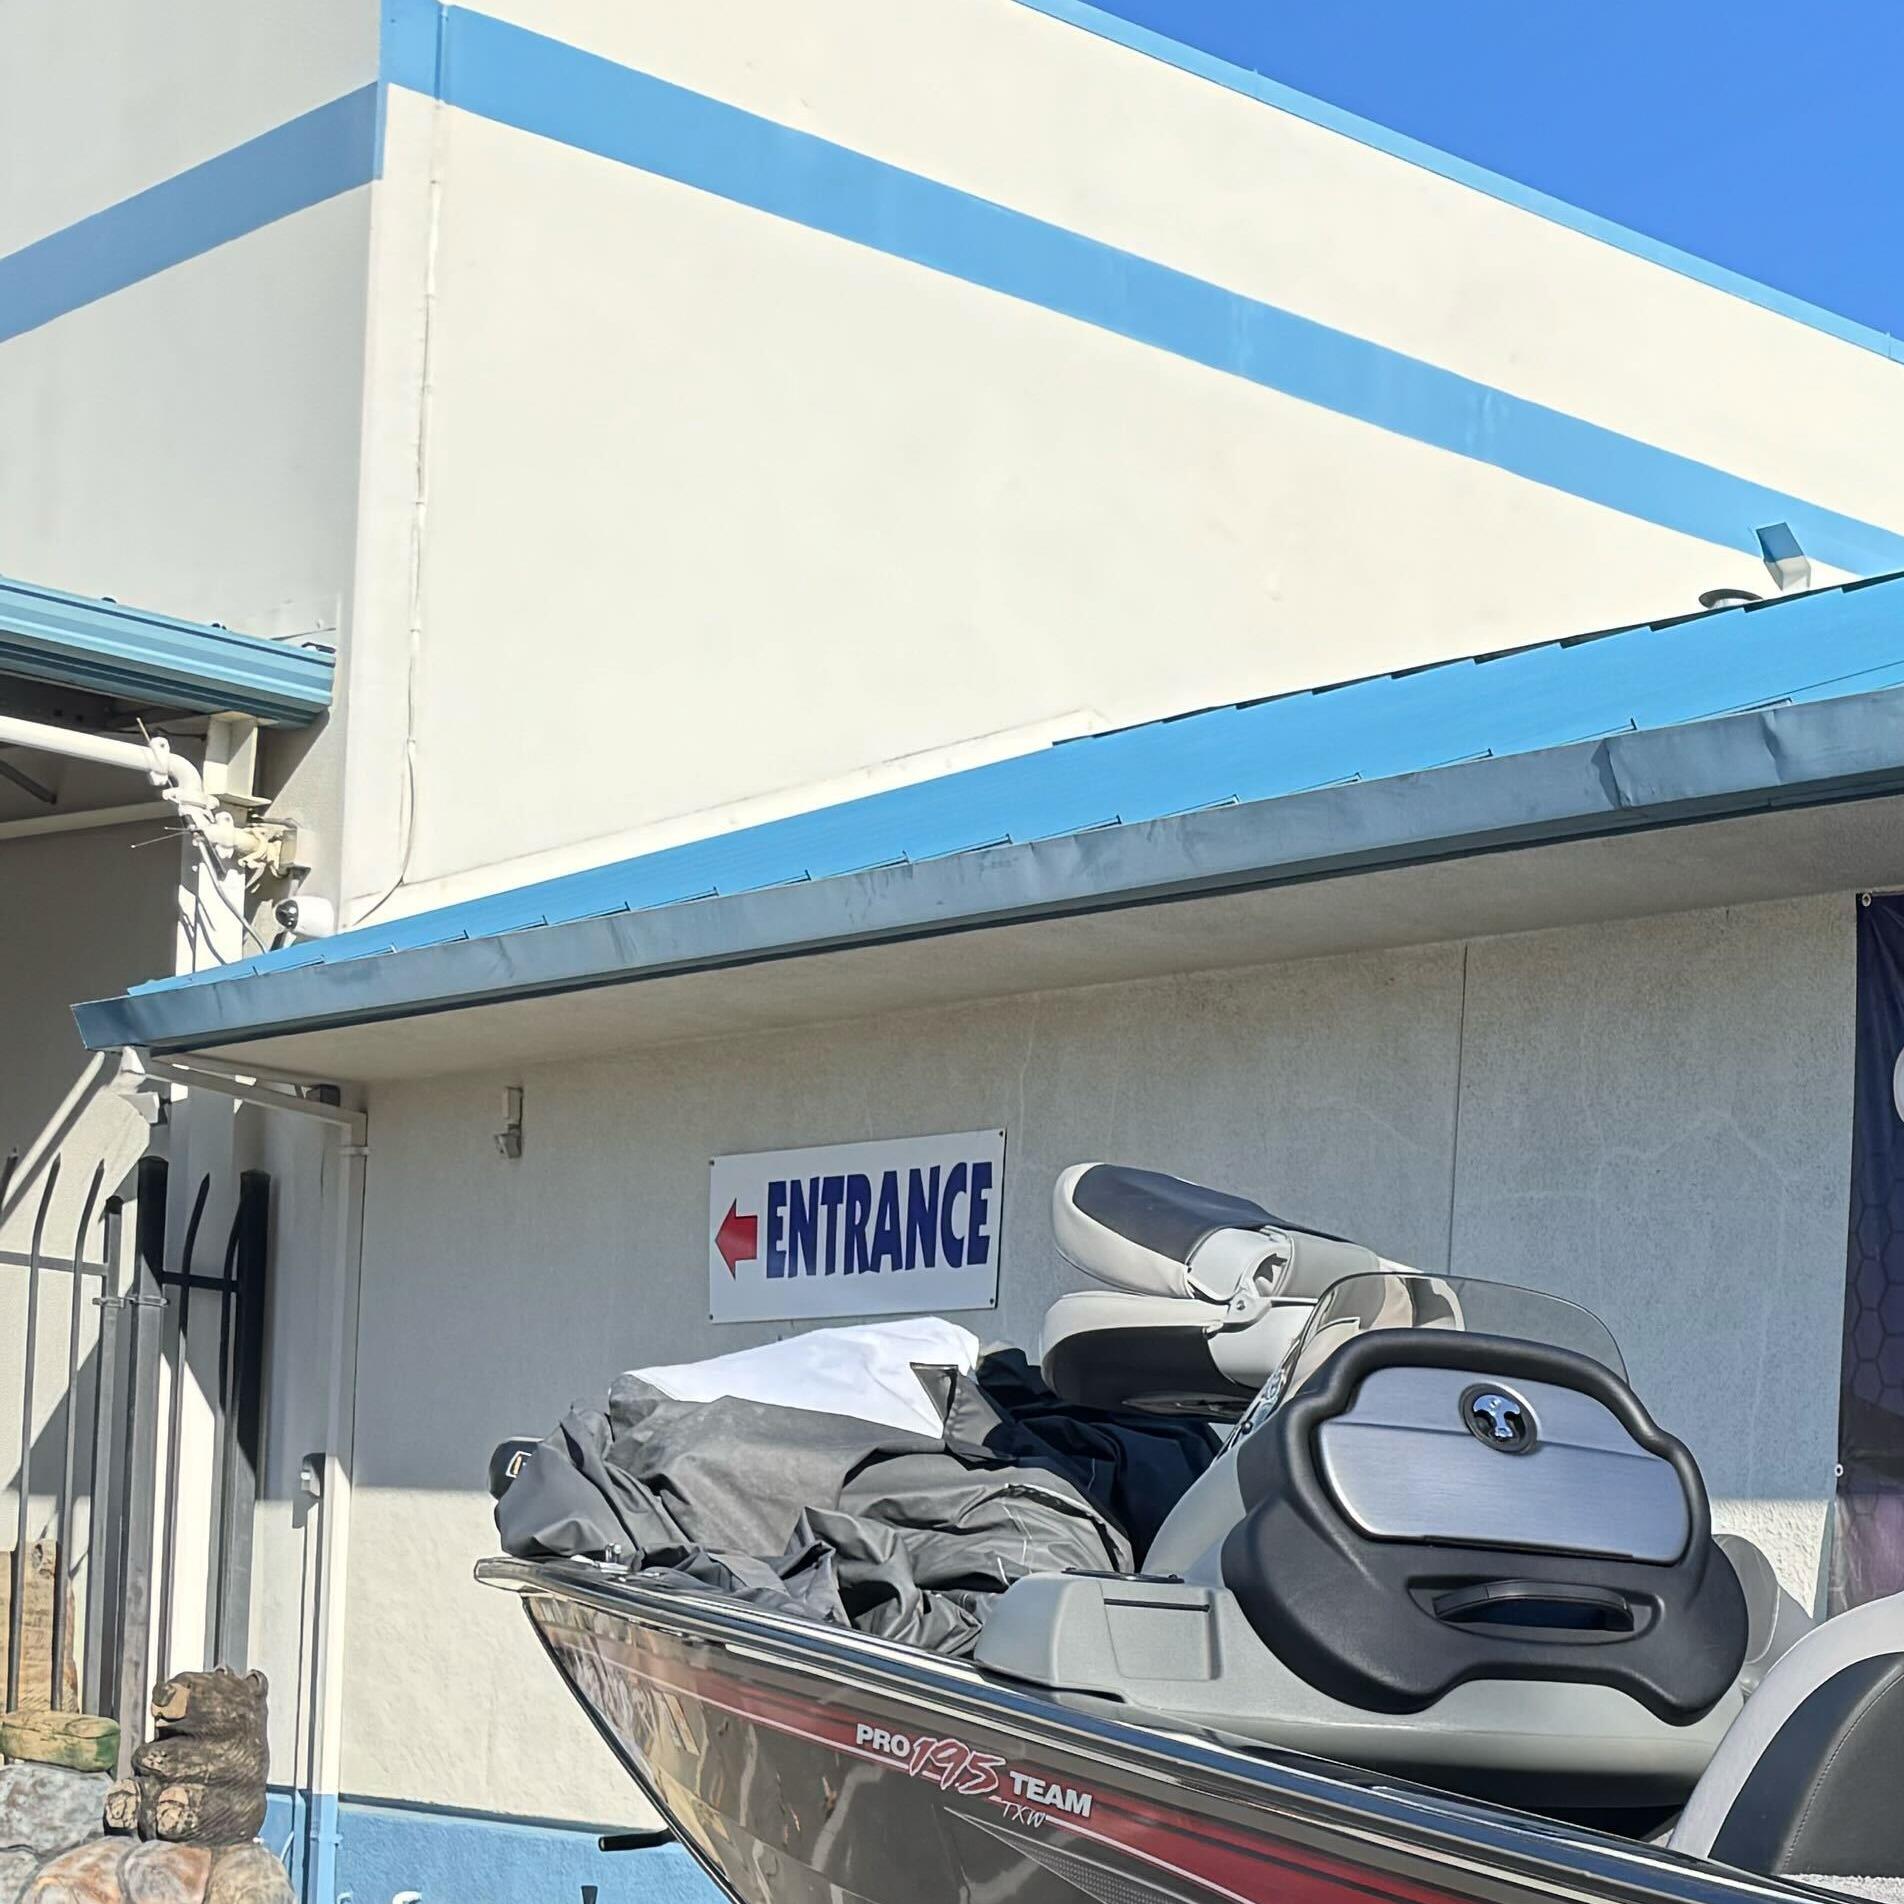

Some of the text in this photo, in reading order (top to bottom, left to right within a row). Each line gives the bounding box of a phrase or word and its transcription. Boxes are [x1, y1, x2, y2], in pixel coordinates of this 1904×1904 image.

[766, 1161, 993, 1279] ENTRANCE
[856, 1723, 1093, 1818] PRO 195 TEAM
[1001, 1801, 1047, 1828] TXW
